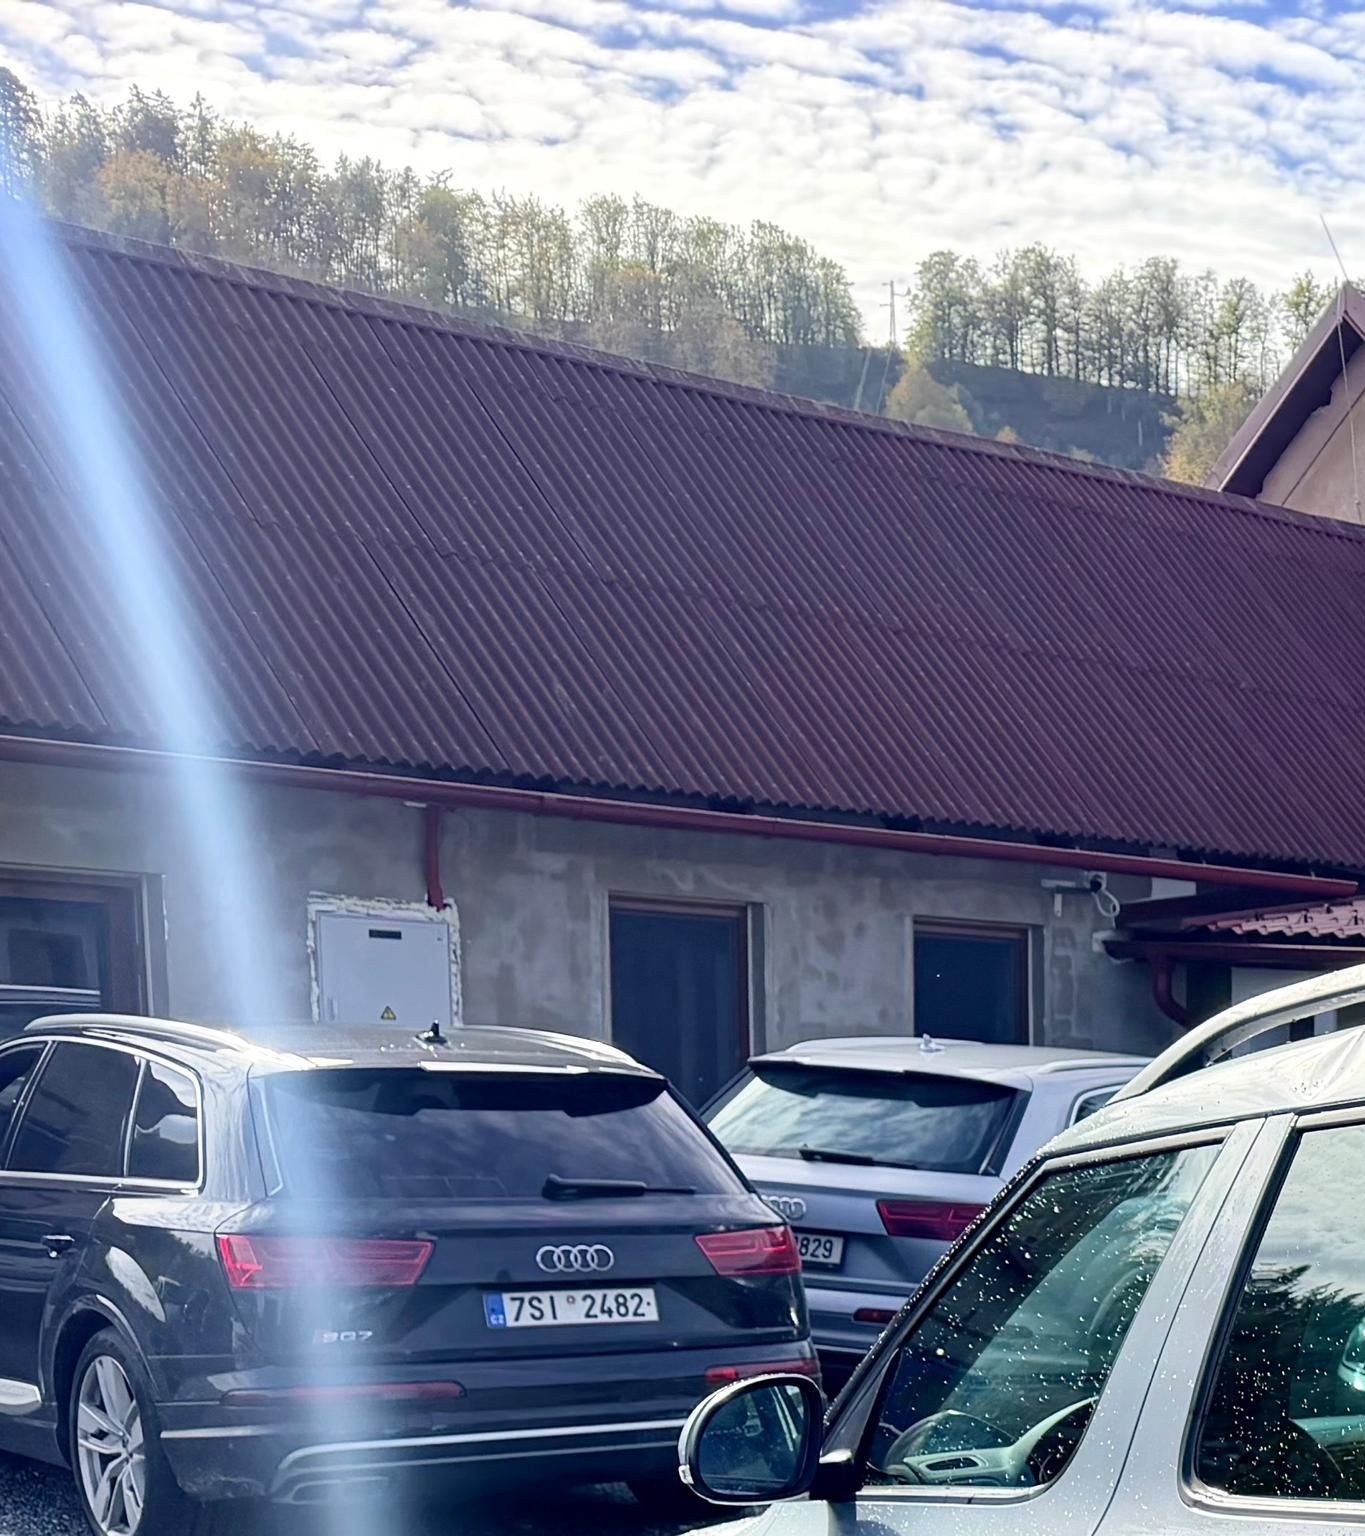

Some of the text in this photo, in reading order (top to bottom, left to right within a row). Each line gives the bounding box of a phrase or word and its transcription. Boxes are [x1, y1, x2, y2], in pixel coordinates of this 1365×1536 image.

[795, 1236, 833, 1259] 829
[509, 1295, 557, 1322] 7SI
[582, 1293, 645, 1319] 2482
